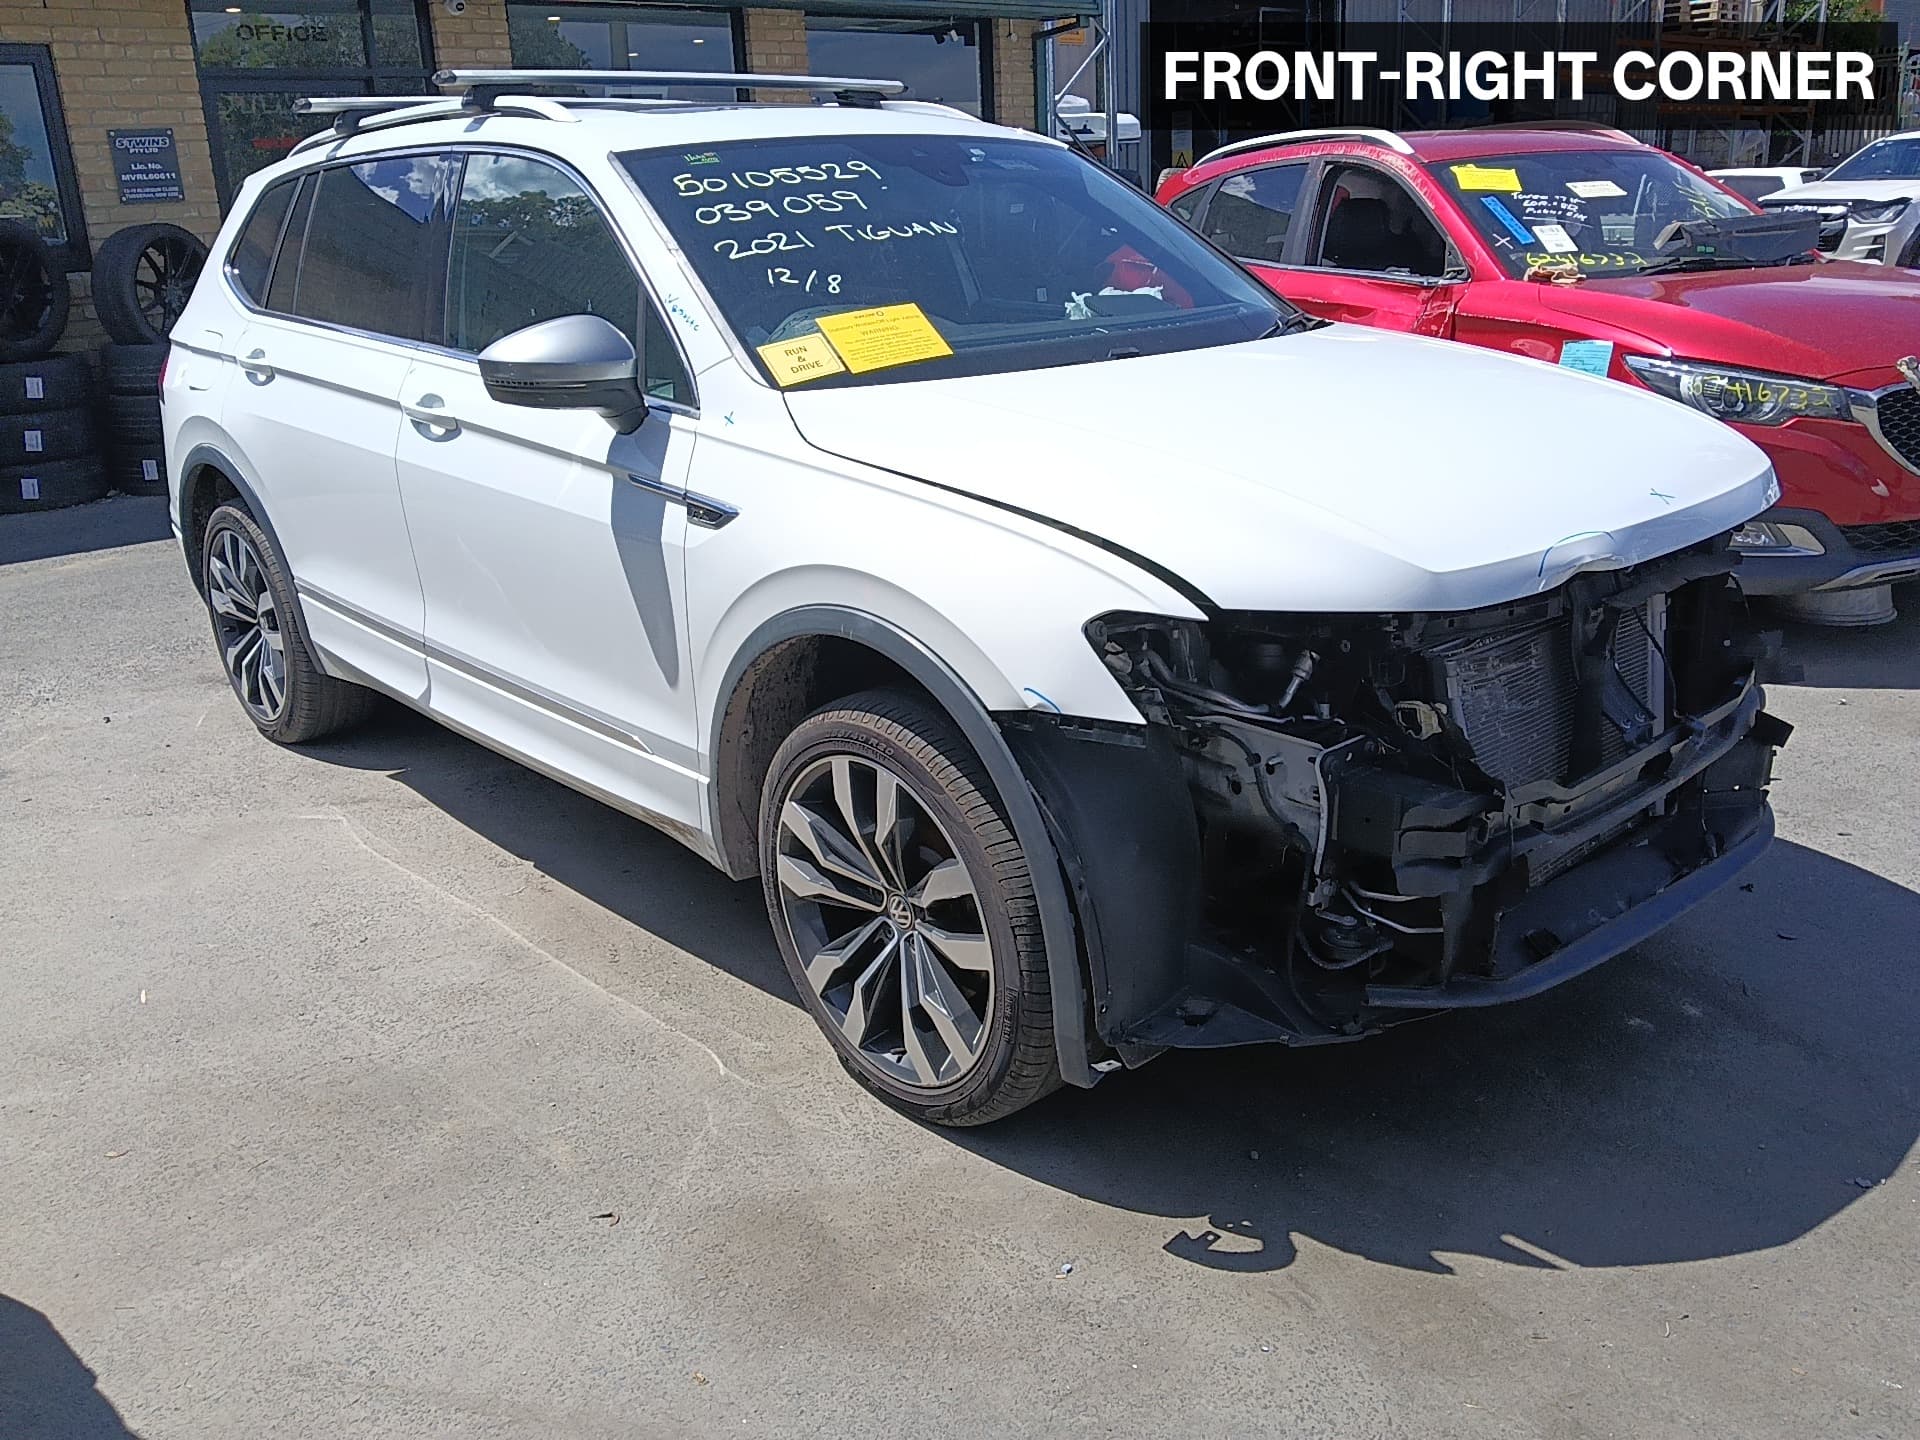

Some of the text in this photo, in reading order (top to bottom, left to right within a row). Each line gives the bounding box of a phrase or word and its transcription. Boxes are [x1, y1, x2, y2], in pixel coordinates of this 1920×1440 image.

[236, 25, 328, 42] OFFICE
[673, 160, 882, 196] 50105529
[713, 220, 958, 260] 2021 TIGUAN
[784, 345, 808, 356] RUN
[790, 359, 824, 374] DRIVE
[797, 355, 807, 363] &
